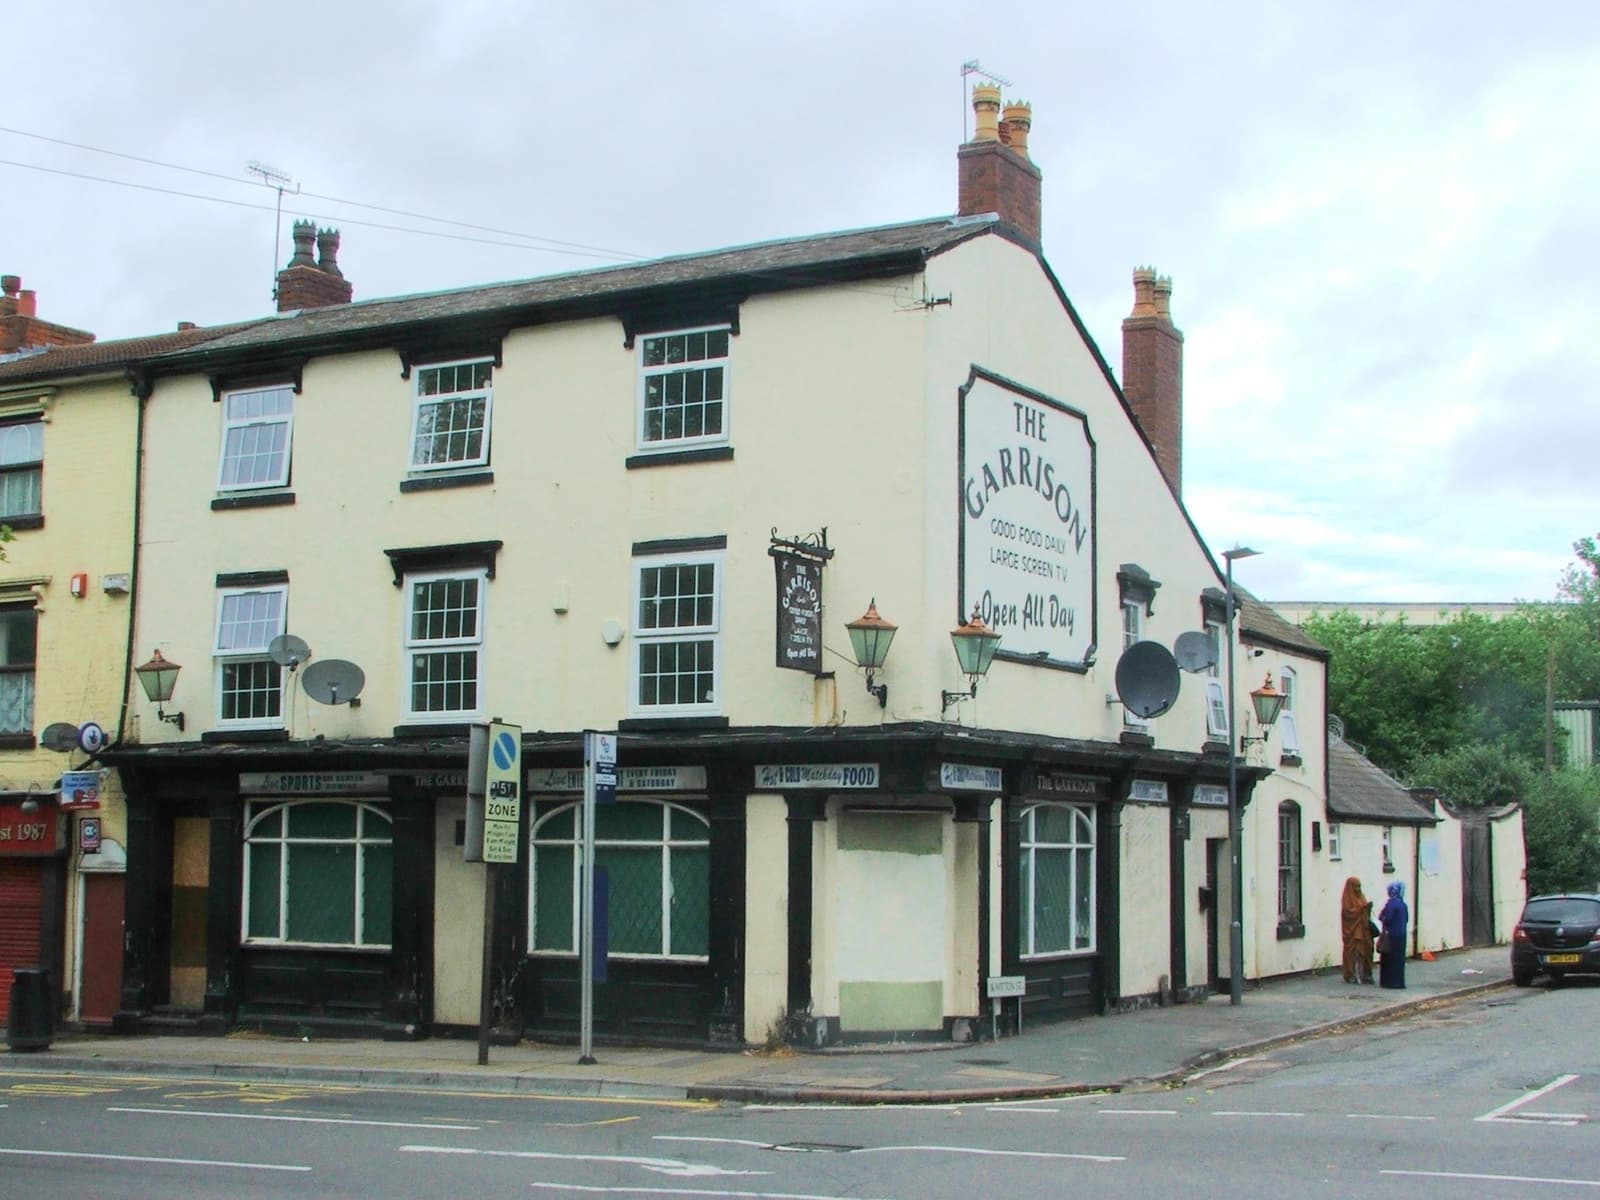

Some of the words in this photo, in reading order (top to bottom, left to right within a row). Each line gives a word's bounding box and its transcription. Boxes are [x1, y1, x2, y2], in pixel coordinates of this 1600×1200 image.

[1013, 401, 1047, 442] THE
[966, 446, 1087, 555] GARRISON
[991, 518, 1016, 540] GOOD
[1019, 526, 1043, 548] FOOD
[1045, 535, 1067, 555] DAILY
[990, 547, 1019, 570] LARGE
[1022, 555, 1053, 579] SCREEN
[782, 575, 821, 613] GARRISON
[982, 589, 1017, 632] Open
[1022, 592, 1045, 632] All
[1049, 593, 1075, 637] Day
[416, 775, 432, 786] THE
[651, 767, 677, 777] FRIDAY
[801, 767, 841, 784] Matchday
[843, 766, 875, 786] FOOD
[280, 775, 321, 791] SPORTS
[636, 779, 675, 788] SATURDAY
[1037, 775, 1052, 790] THE
[1055, 779, 1096, 793] GARRISON
[488, 803, 516, 817] ZONE
[17, 823, 48, 840] 1987
